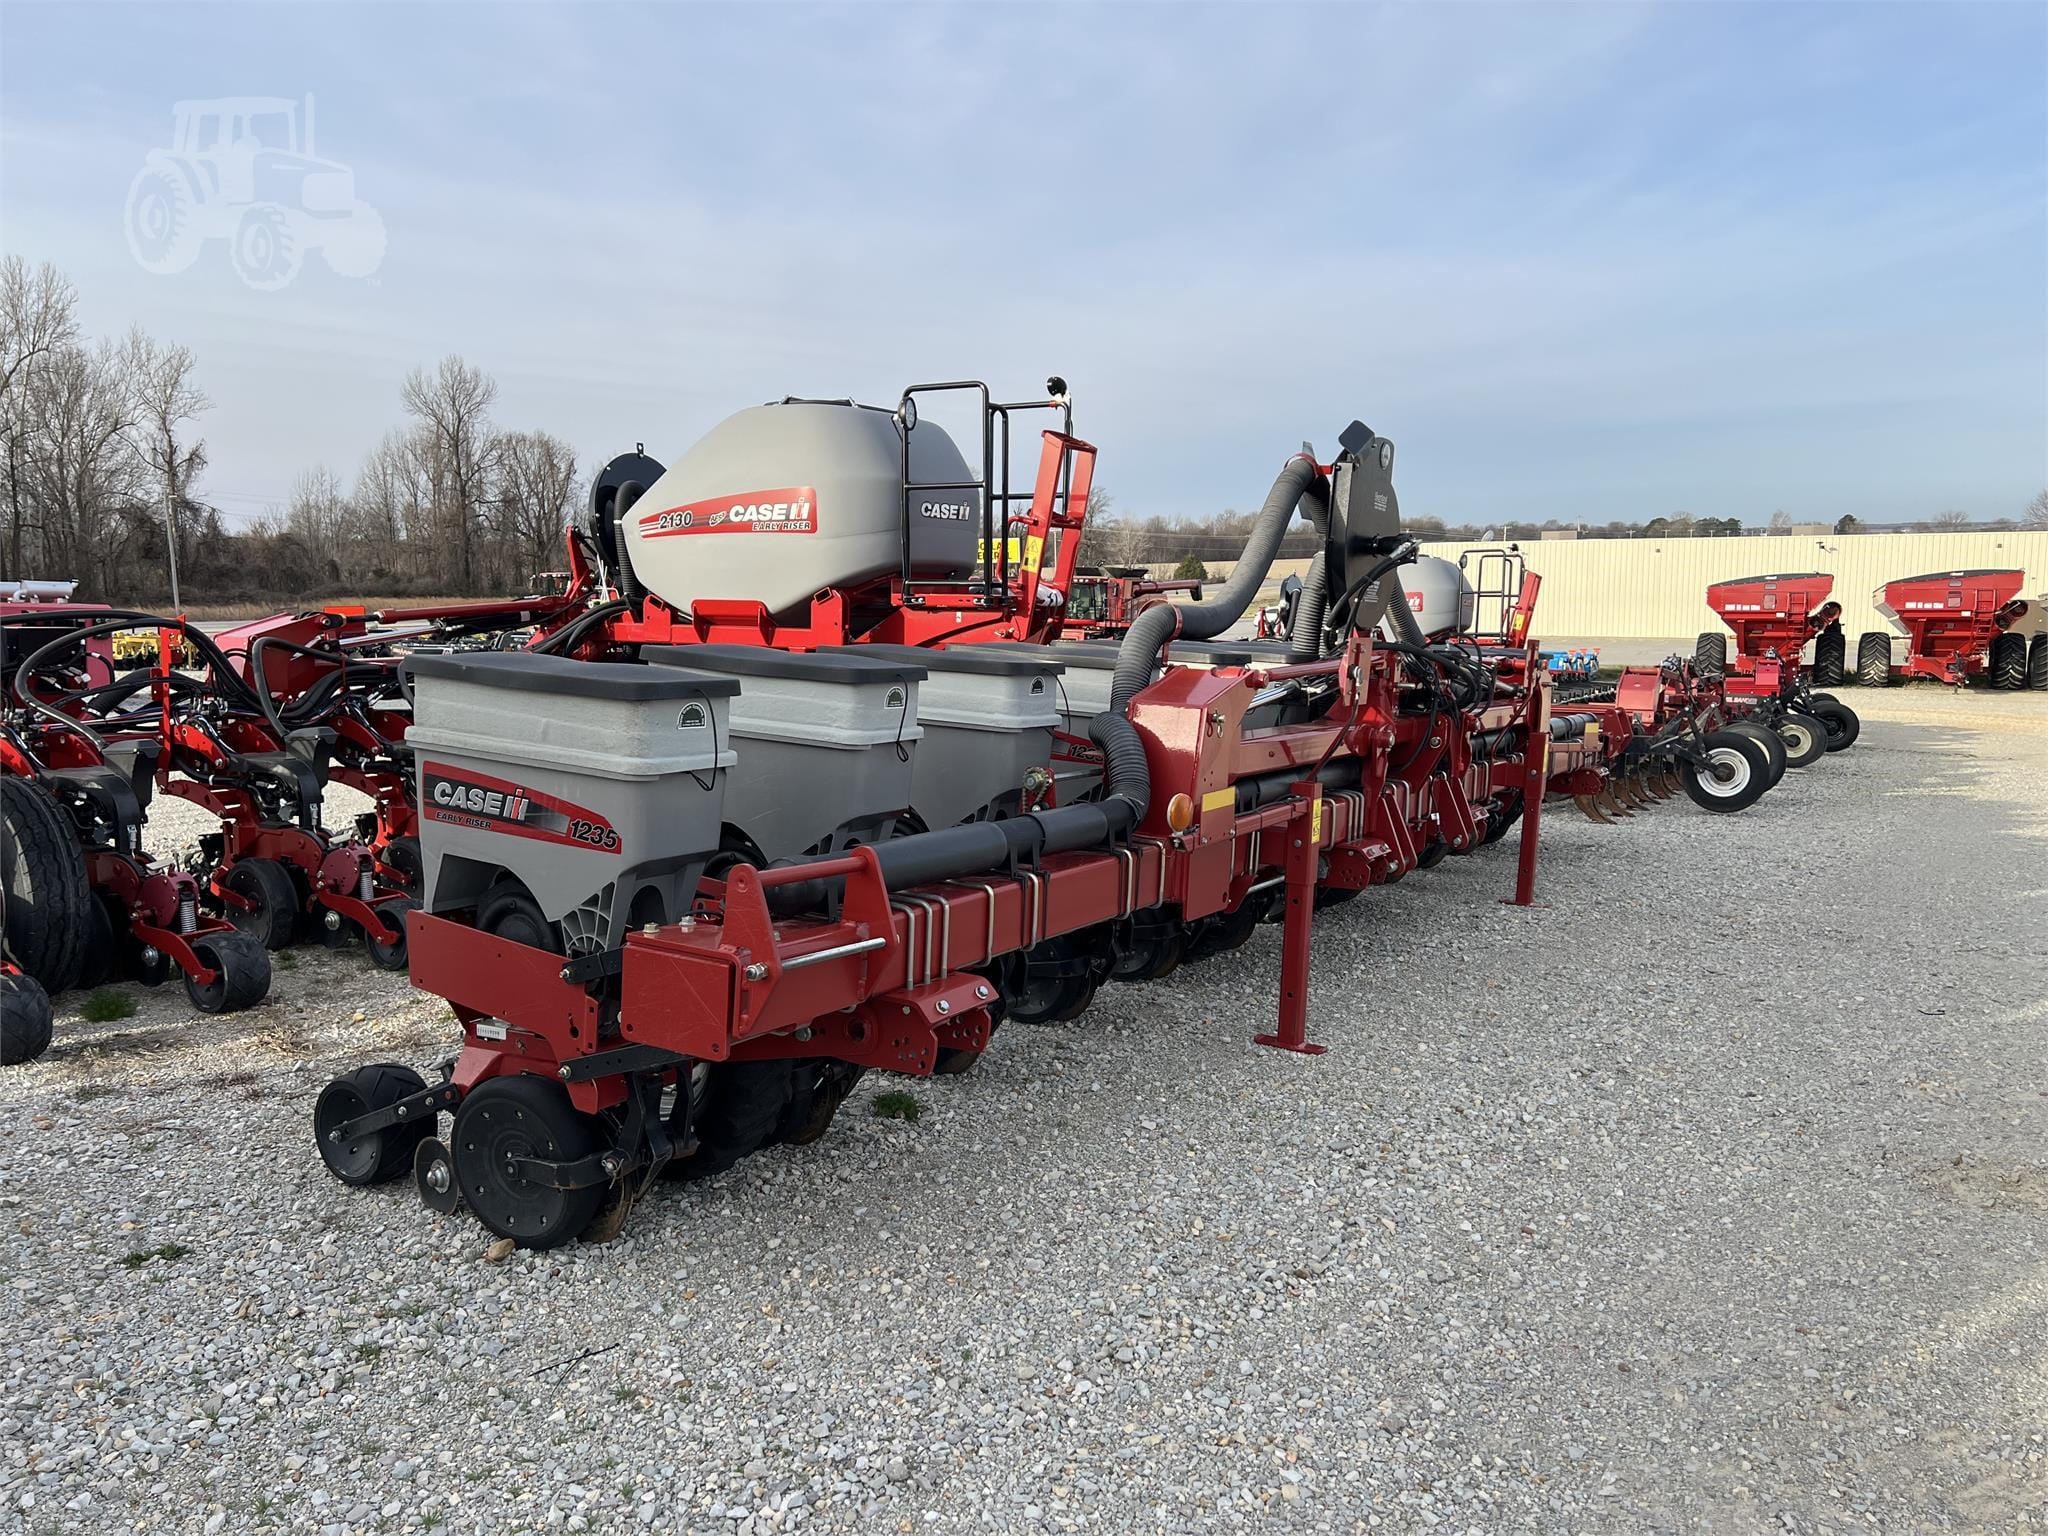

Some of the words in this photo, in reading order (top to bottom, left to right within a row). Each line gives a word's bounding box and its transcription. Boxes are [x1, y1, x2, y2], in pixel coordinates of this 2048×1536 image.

[659, 511, 694, 529] 2130
[729, 503, 787, 522] CASE
[921, 501, 959, 519] CASE
[752, 521, 781, 531] EARLY
[782, 521, 811, 531] RISER
[433, 781, 504, 816] CASE
[436, 811, 468, 824] EARLY
[465, 818, 492, 829] RISER
[570, 819, 619, 849] 1235
